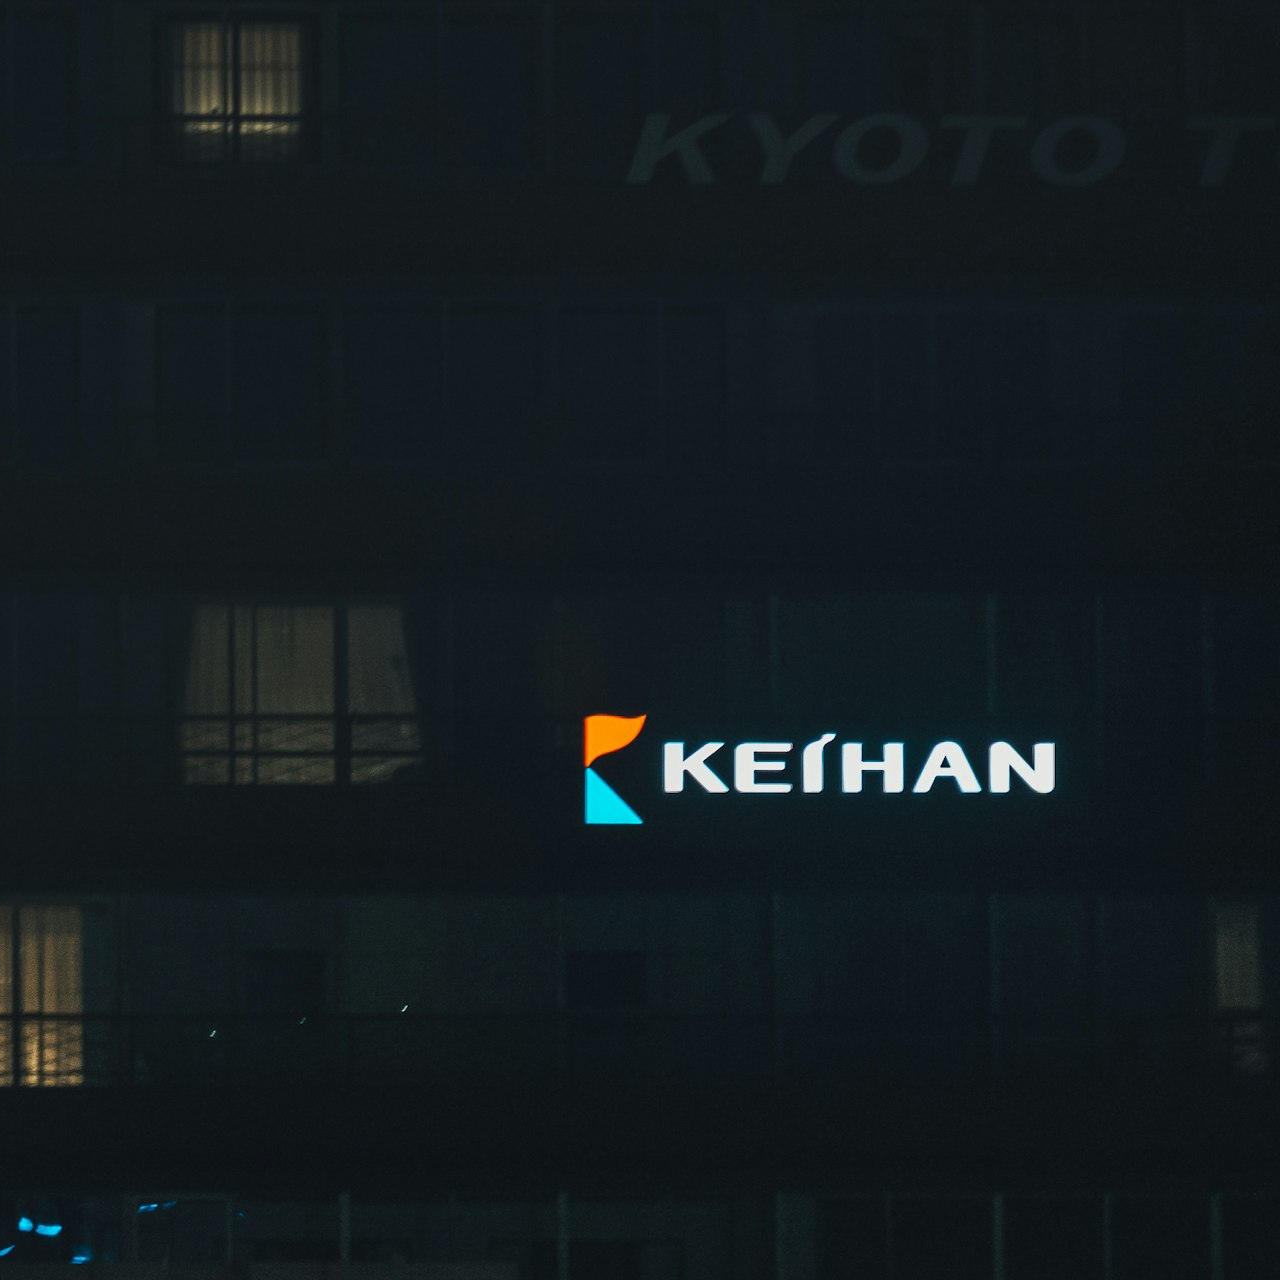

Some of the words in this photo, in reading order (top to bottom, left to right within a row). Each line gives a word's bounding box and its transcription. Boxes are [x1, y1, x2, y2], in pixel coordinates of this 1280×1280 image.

[625, 111, 1127, 187] KYOTO
[1185, 113, 1280, 187] T
[661, 733, 1057, 796] KEIHAN
